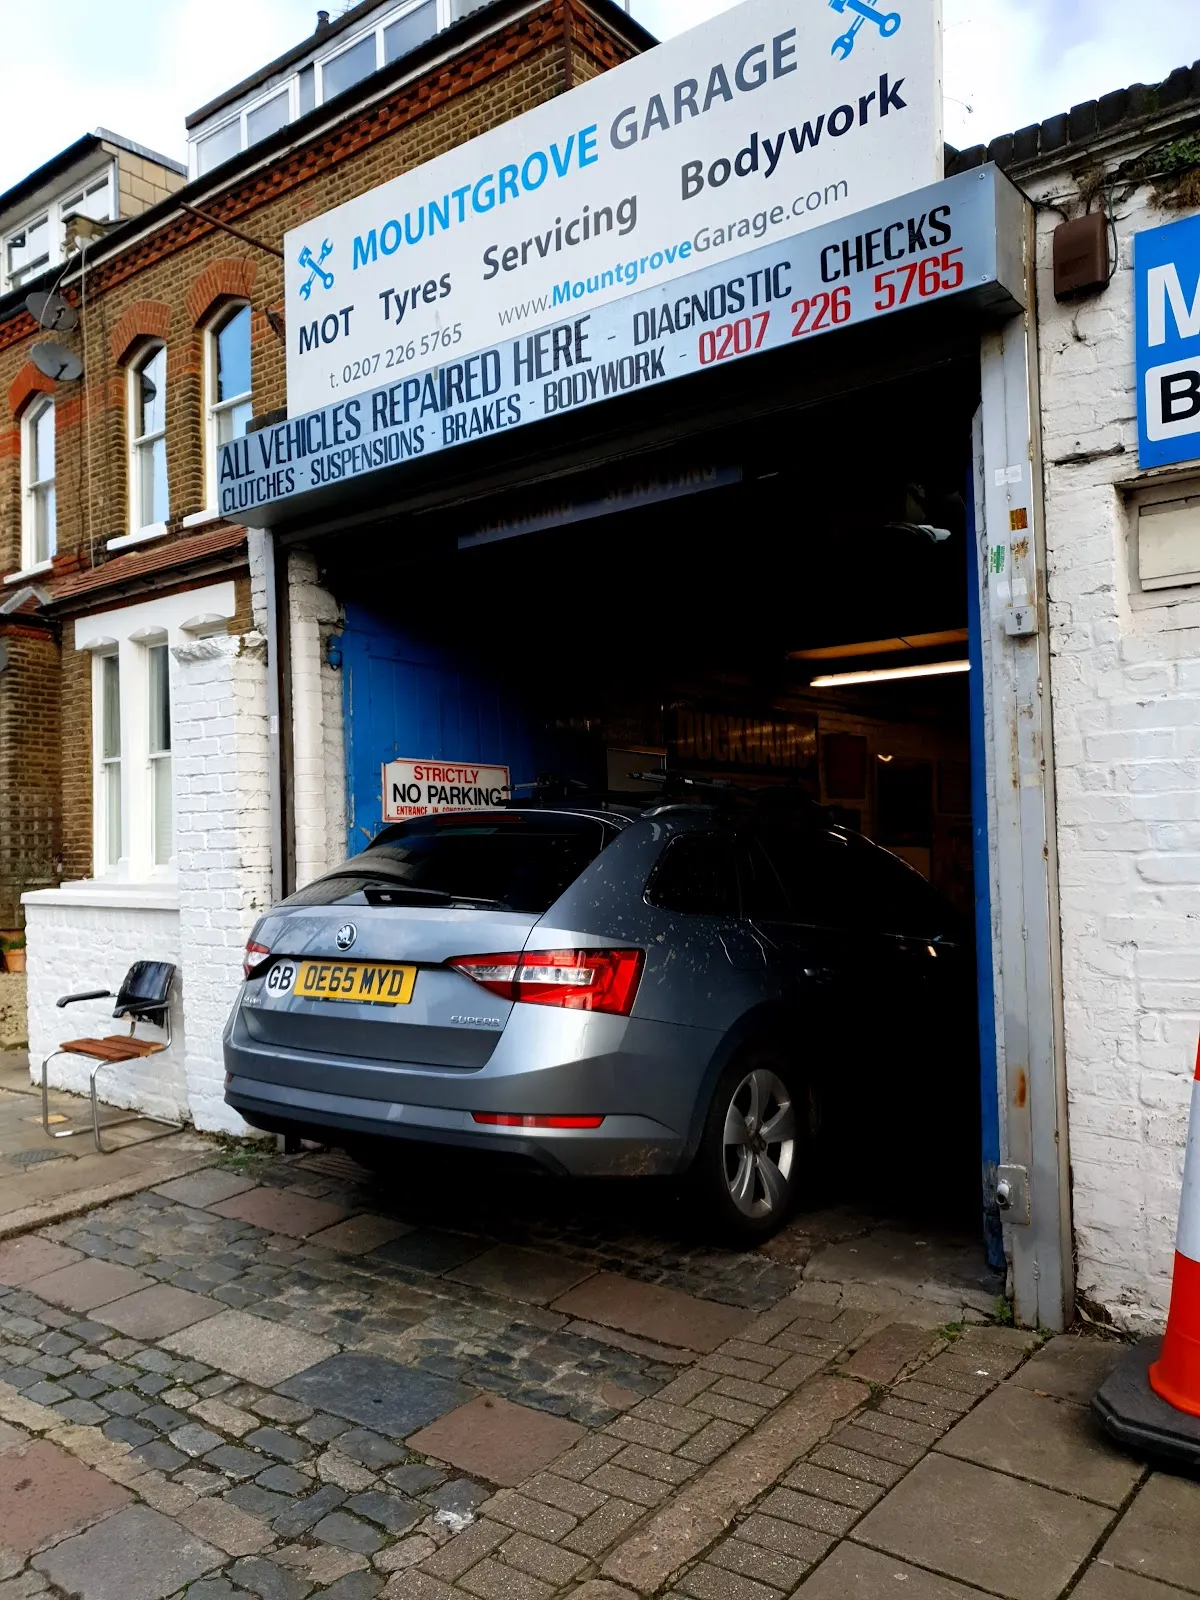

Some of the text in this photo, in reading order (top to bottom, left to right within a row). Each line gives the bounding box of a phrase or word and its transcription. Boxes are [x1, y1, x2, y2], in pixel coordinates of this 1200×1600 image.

[352, 28, 798, 270] MOUNTGROVE GARAGE
[299, 73, 907, 355] MOT Tyres Servicing Bodywork
[498, 179, 849, 327] www.MountgroveGarage.com
[220, 205, 952, 484] ALL VEHICLES REPAIRED HERE DIAGNOSTIC CHECKS
[342, 356, 381, 384] 0207
[385, 341, 416, 372] 226
[420, 323, 462, 356] 5765
[222, 247, 964, 513] CLUTCHES SUSPENSIONS BRAKES BODYWORK 0207 226 5765
[393, 783, 502, 806] NO PARKING
[414, 765, 479, 784] STRICTLY
[268, 965, 295, 990] GB
[303, 964, 404, 996] OE65 MYD
[450, 1015, 501, 1028] SUPERB
